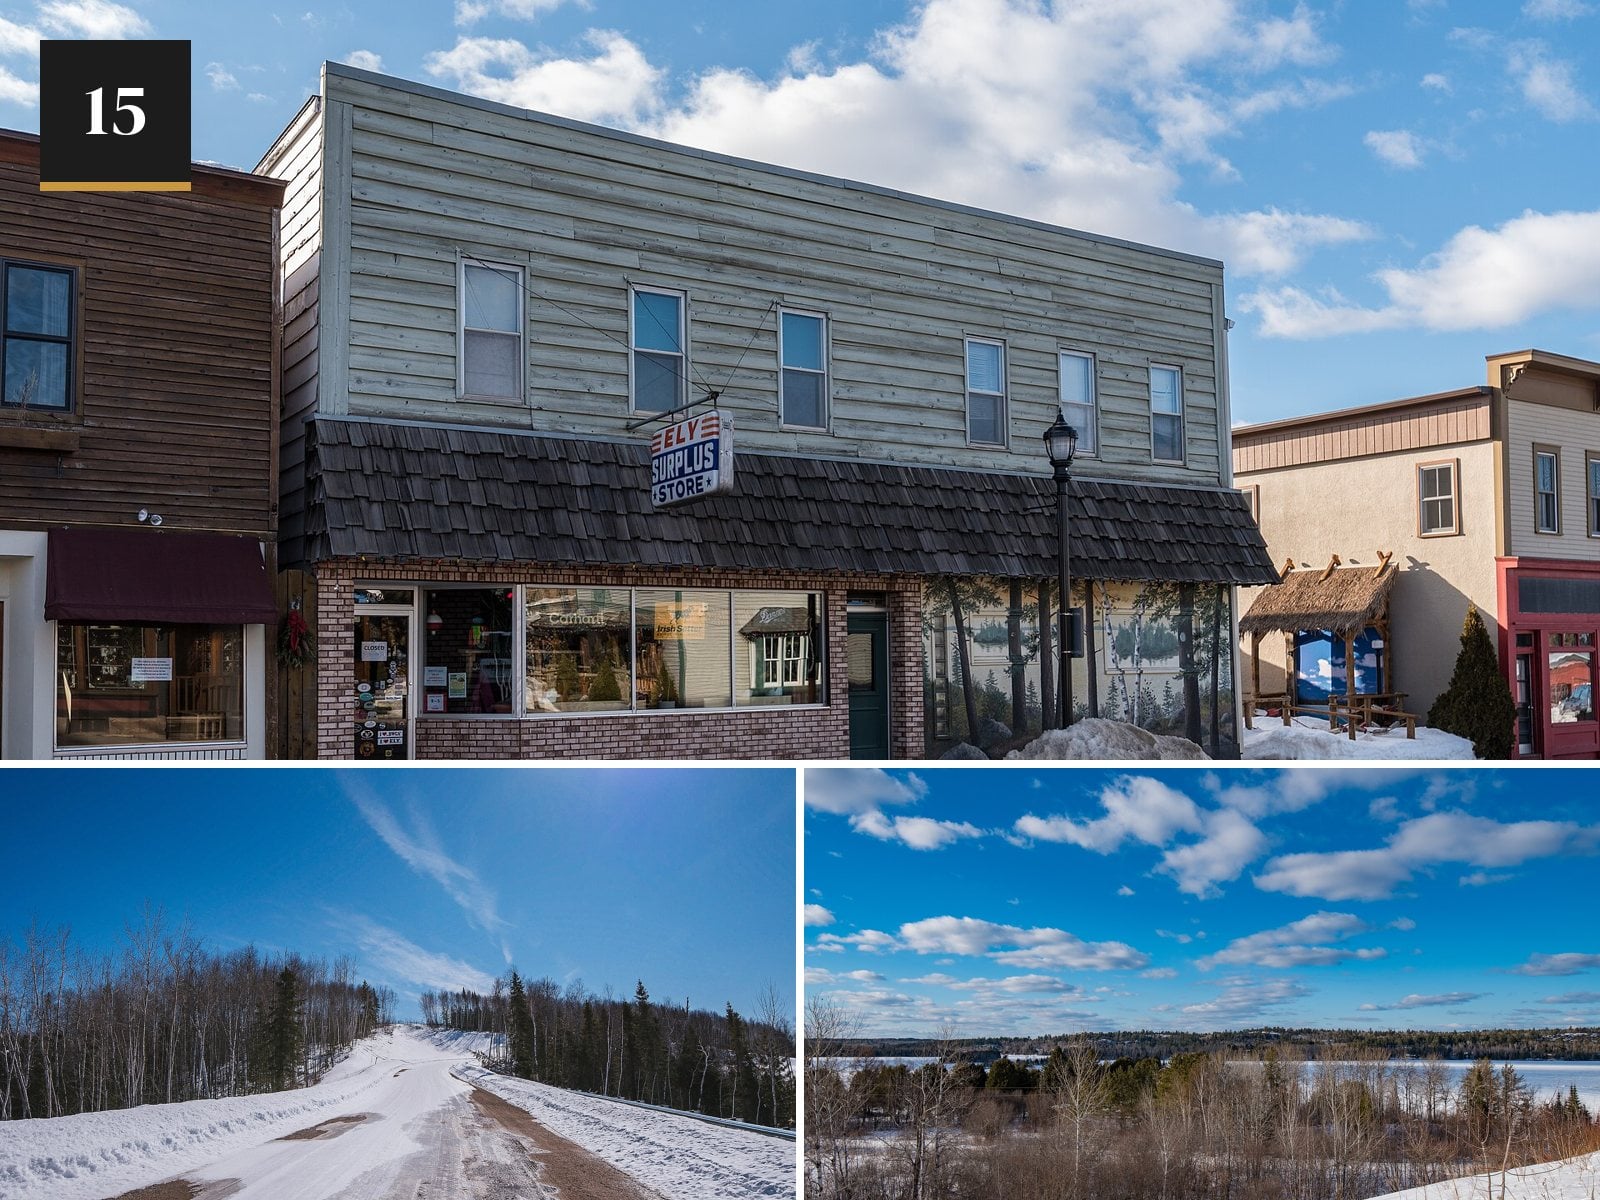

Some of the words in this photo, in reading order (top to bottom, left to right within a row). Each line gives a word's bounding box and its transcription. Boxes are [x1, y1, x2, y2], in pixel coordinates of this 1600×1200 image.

[664, 418, 699, 449] ELY
[652, 441, 714, 484] SURPLUS
[658, 475, 704, 503] STORE
[657, 625, 676, 633] Irish
